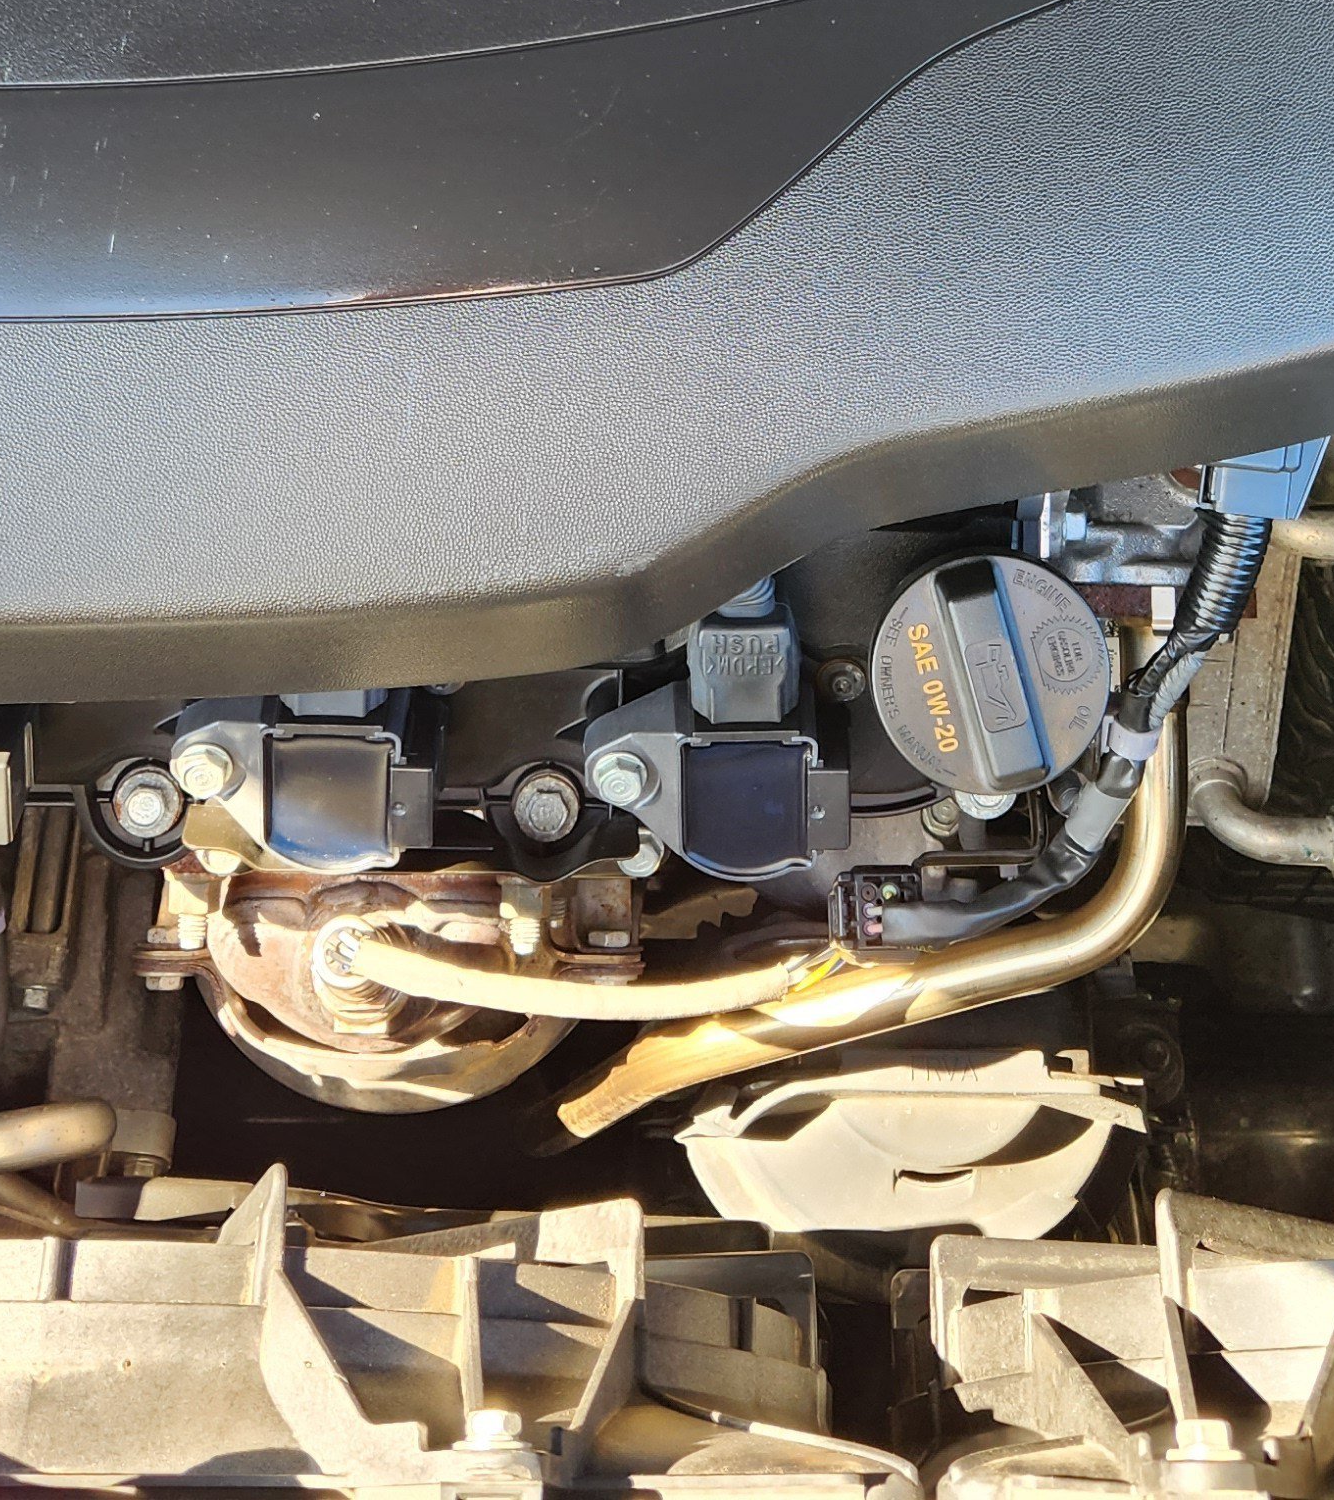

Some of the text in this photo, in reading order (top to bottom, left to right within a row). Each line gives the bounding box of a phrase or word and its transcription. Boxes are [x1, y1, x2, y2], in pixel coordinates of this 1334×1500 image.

[1013, 568, 1071, 613] ENGINE
[711, 633, 781, 656] PUSH
[907, 622, 960, 754] SAE 0W-20
[1068, 704, 1092, 731] OIL
